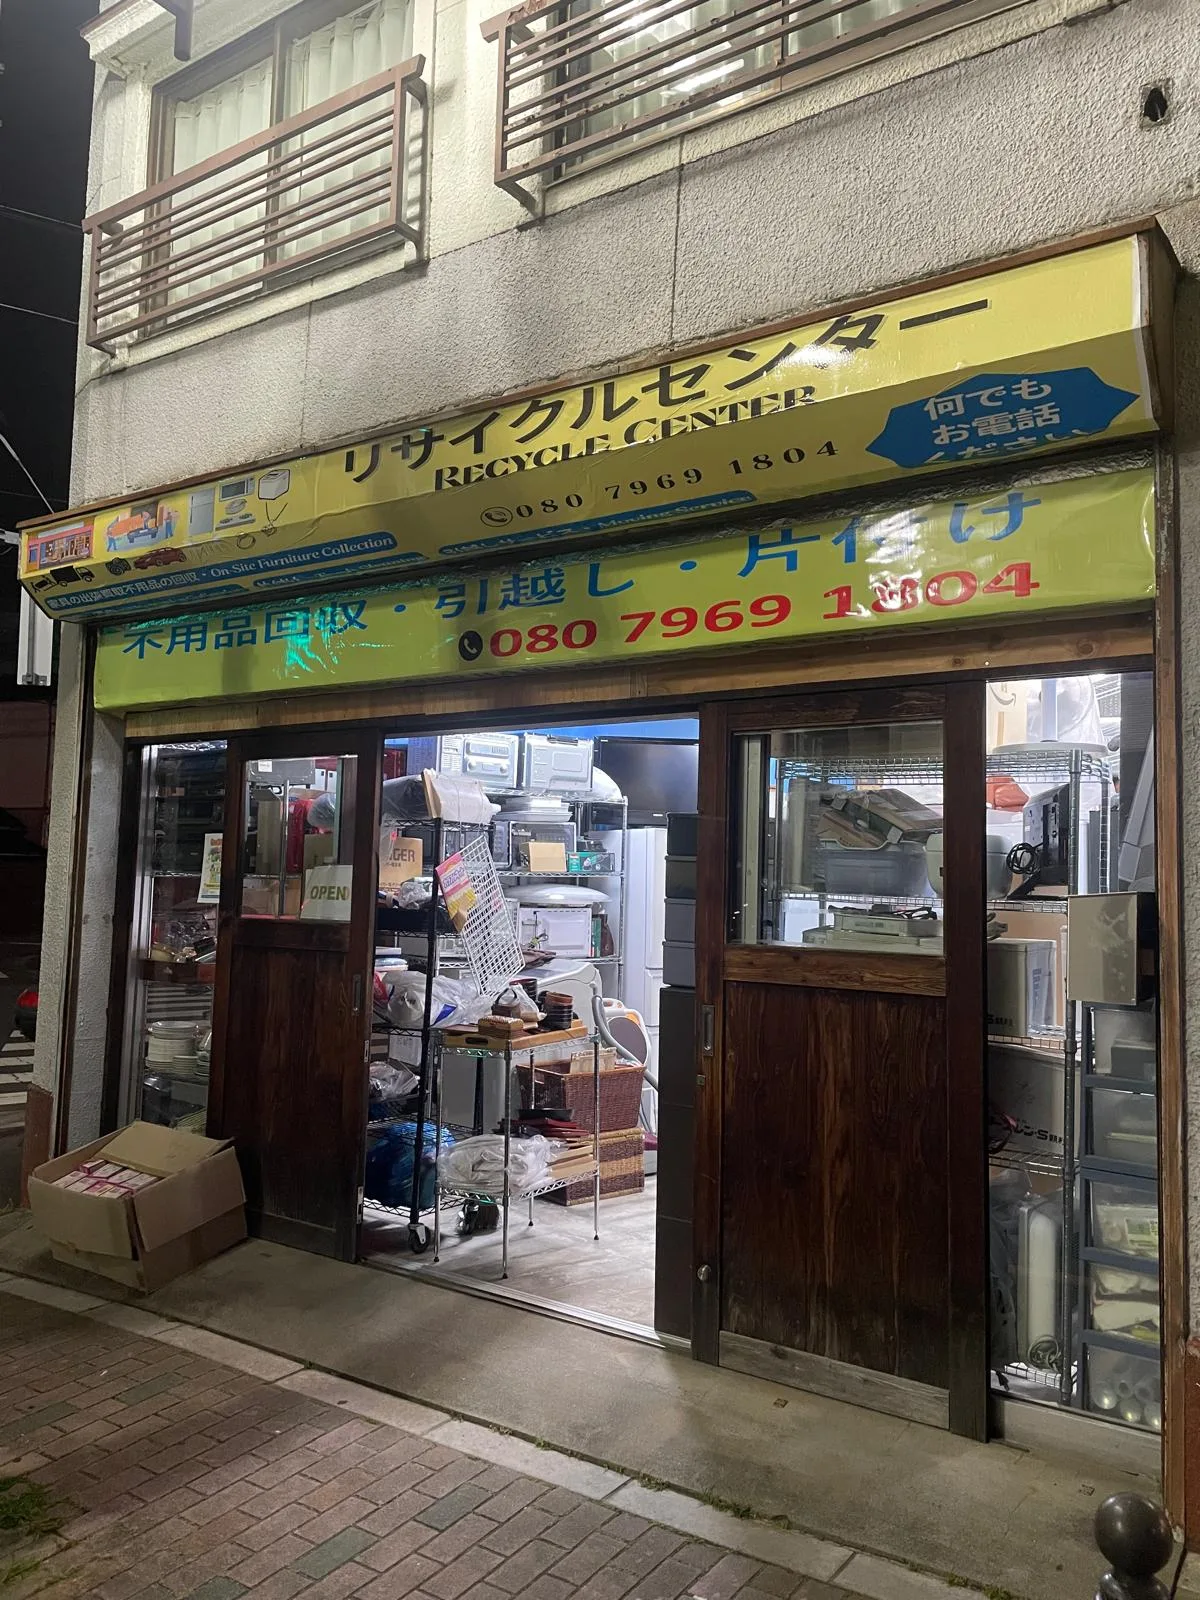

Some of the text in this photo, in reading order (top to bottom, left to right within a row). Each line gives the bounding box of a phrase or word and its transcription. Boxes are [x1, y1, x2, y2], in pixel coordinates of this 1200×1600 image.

[344, 299, 989, 483] リサイクルセンター
[923, 378, 1053, 421] 何でも
[435, 384, 816, 490] RECYCLE CENTER
[931, 402, 1061, 445] お電話
[516, 440, 839, 518] 080 7969 1804
[257, 551, 320, 569] Furniture
[321, 534, 394, 558] Collection
[489, 562, 1042, 658] 080 7969 1804
[310, 885, 347, 901] OPEN
